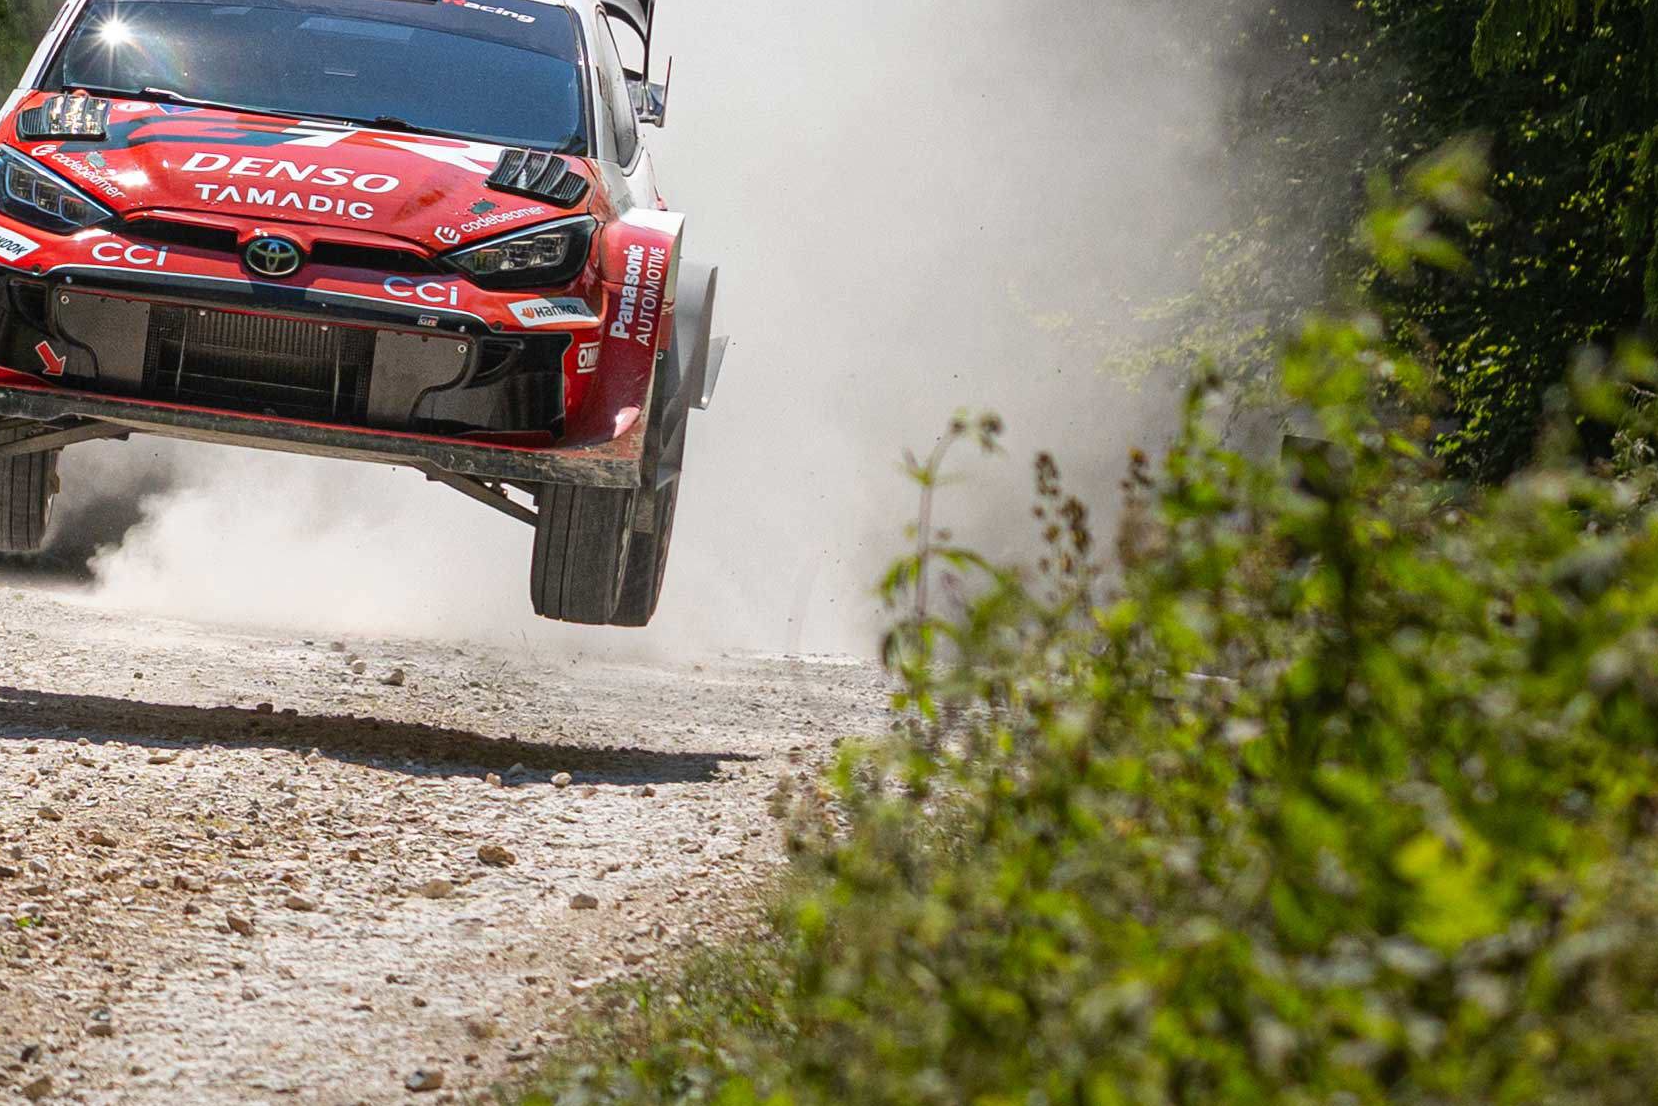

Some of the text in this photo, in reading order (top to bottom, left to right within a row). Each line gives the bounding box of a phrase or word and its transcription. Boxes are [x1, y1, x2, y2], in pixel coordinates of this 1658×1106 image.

[181, 152, 400, 194] DENSO
[194, 183, 374, 220] TAMADIC
[460, 205, 545, 233] codebeamer
[610, 244, 645, 339] Panasonic
[636, 247, 666, 346] AUTOMOTIVE
